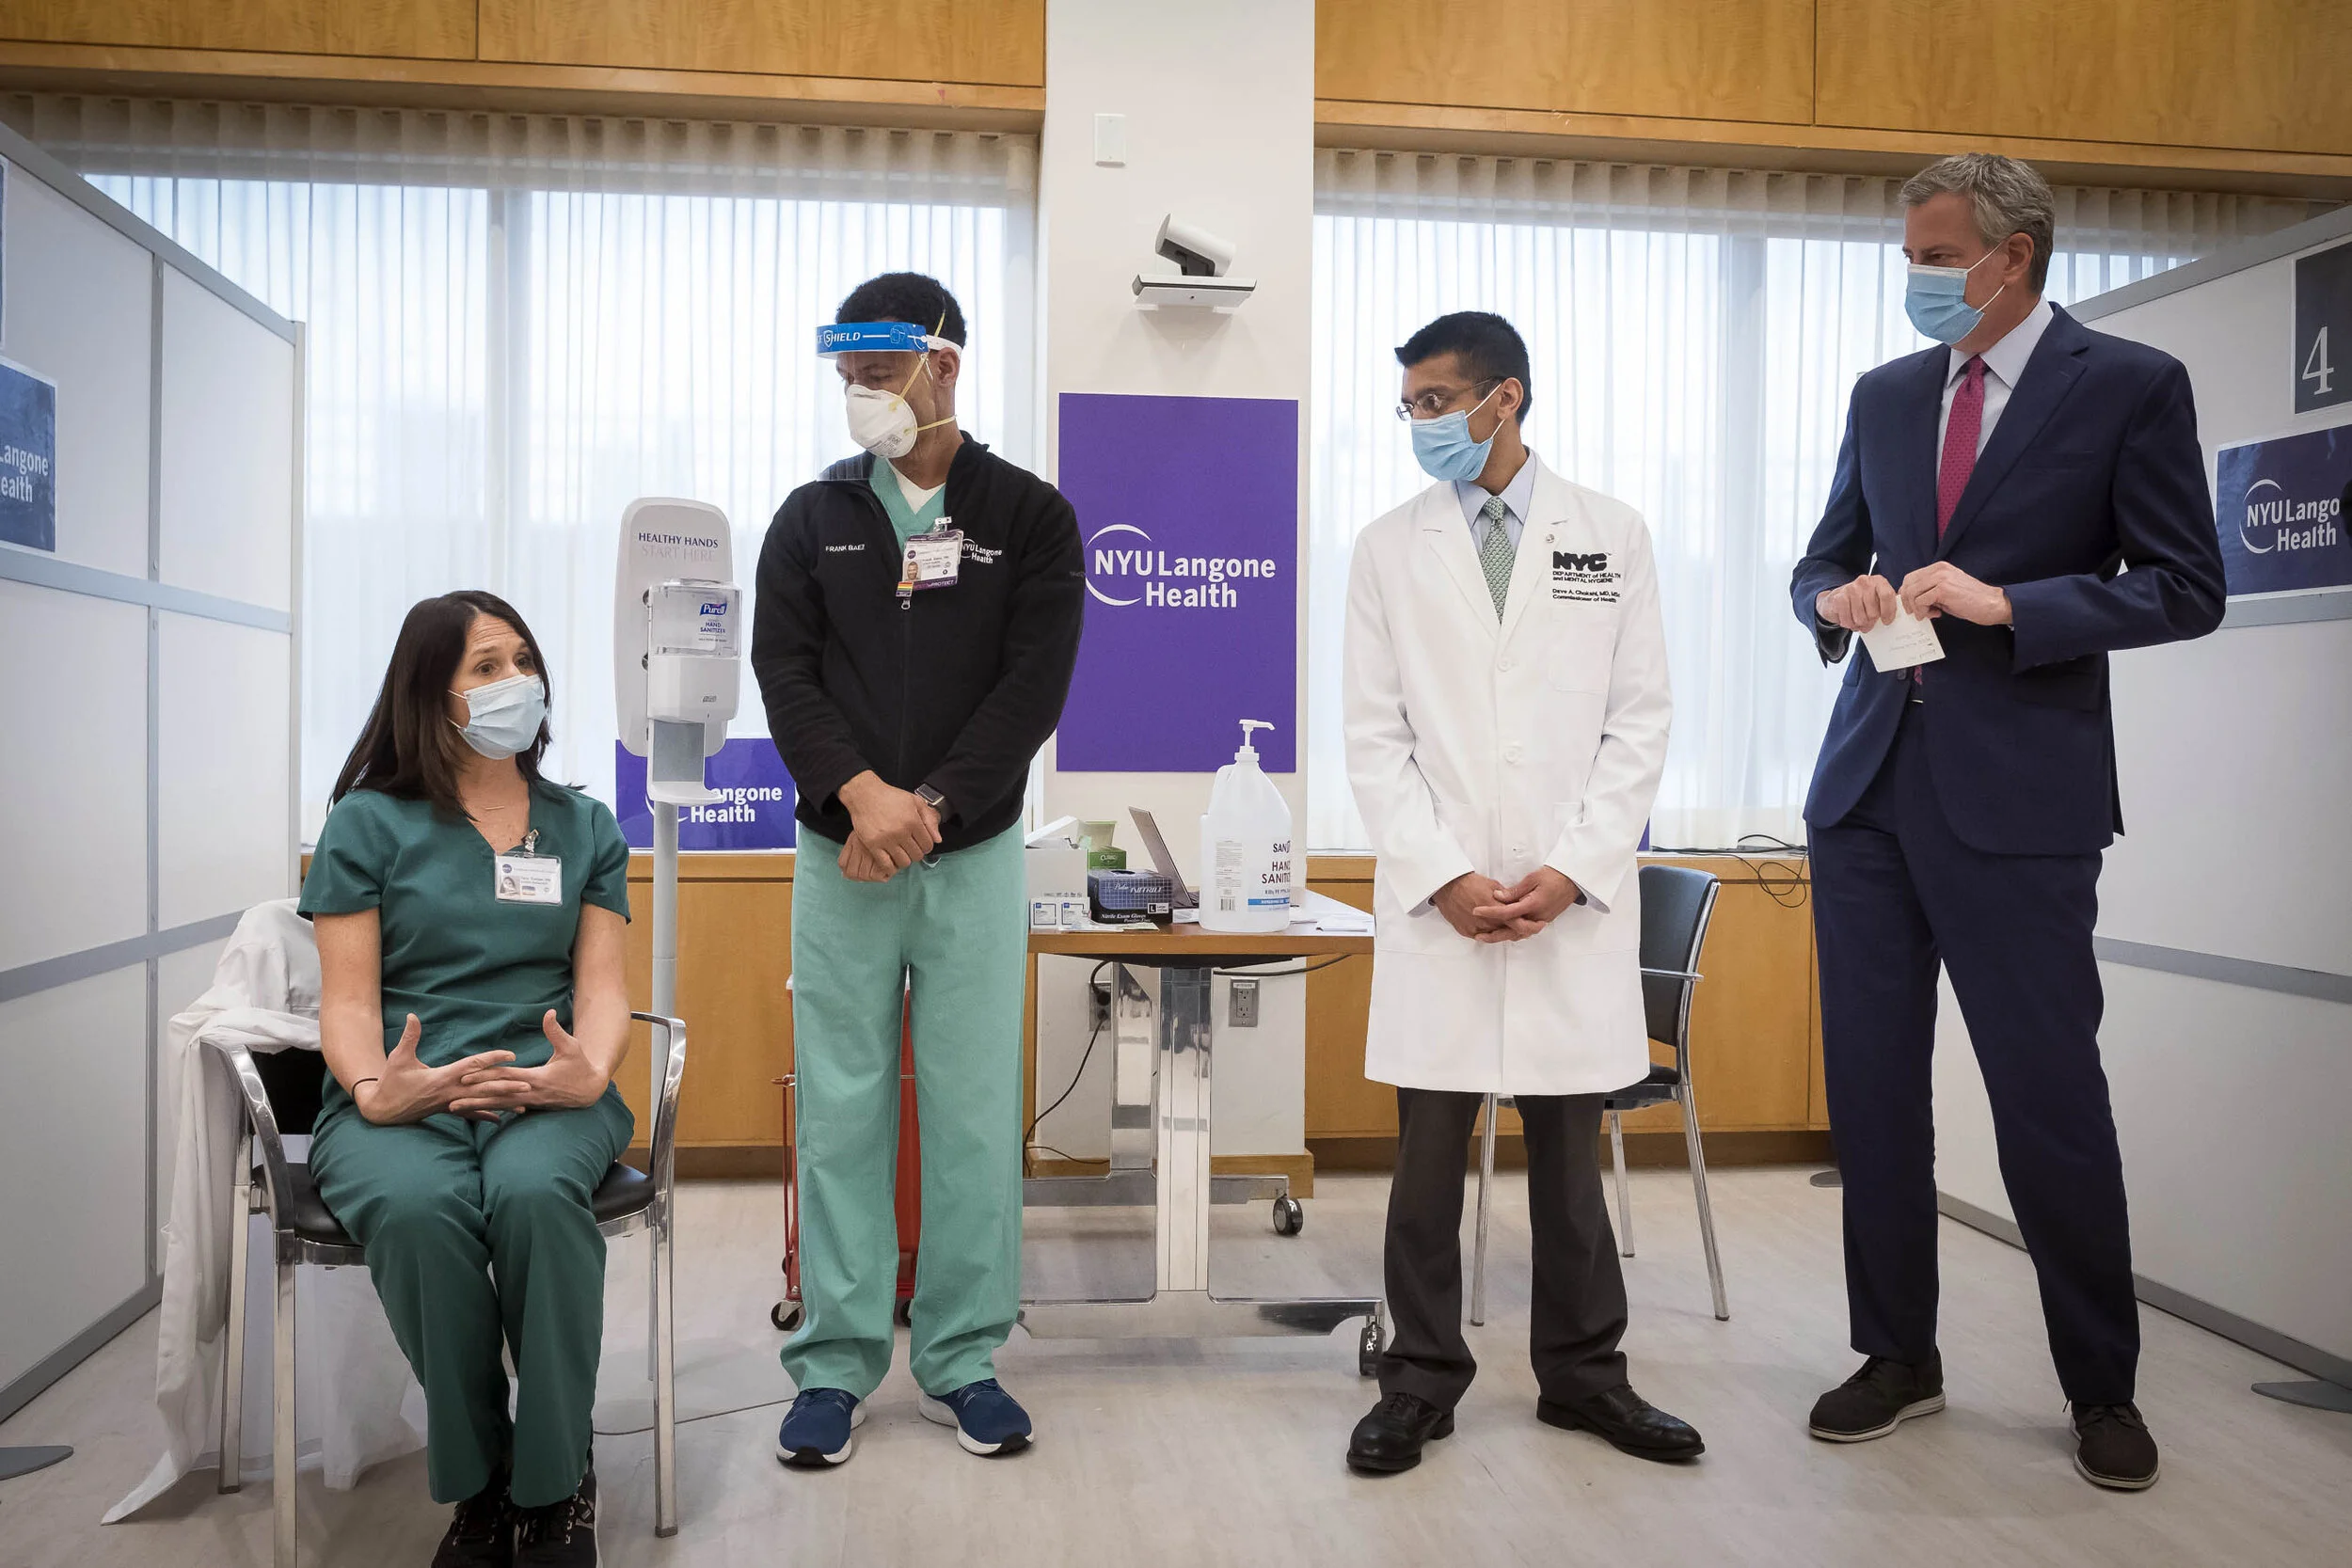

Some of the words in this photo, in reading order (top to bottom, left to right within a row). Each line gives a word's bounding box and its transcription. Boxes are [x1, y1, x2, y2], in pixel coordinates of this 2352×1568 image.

[825, 332, 861, 342] SHIELD
[2302, 325, 2334, 395] 4
[0, 445, 49, 476] angone
[0, 476, 33, 503] ealth
[2247, 499, 2283, 528] NYU
[2285, 498, 2340, 523] Lango
[639, 532, 681, 545] HEALTHY
[684, 536, 719, 548] HANDS
[2277, 522, 2337, 552] Health
[641, 546, 680, 560] START
[683, 548, 715, 562] HERE
[971, 552, 993, 564] Health
[975, 544, 1002, 557] Langone
[1094, 549, 1153, 576] NYU
[1157, 551, 1277, 583] Langone
[1552, 551, 1607, 572] NYC
[1145, 581, 1238, 609] Health
[710, 787, 783, 805] ngone
[691, 804, 755, 823] Health
